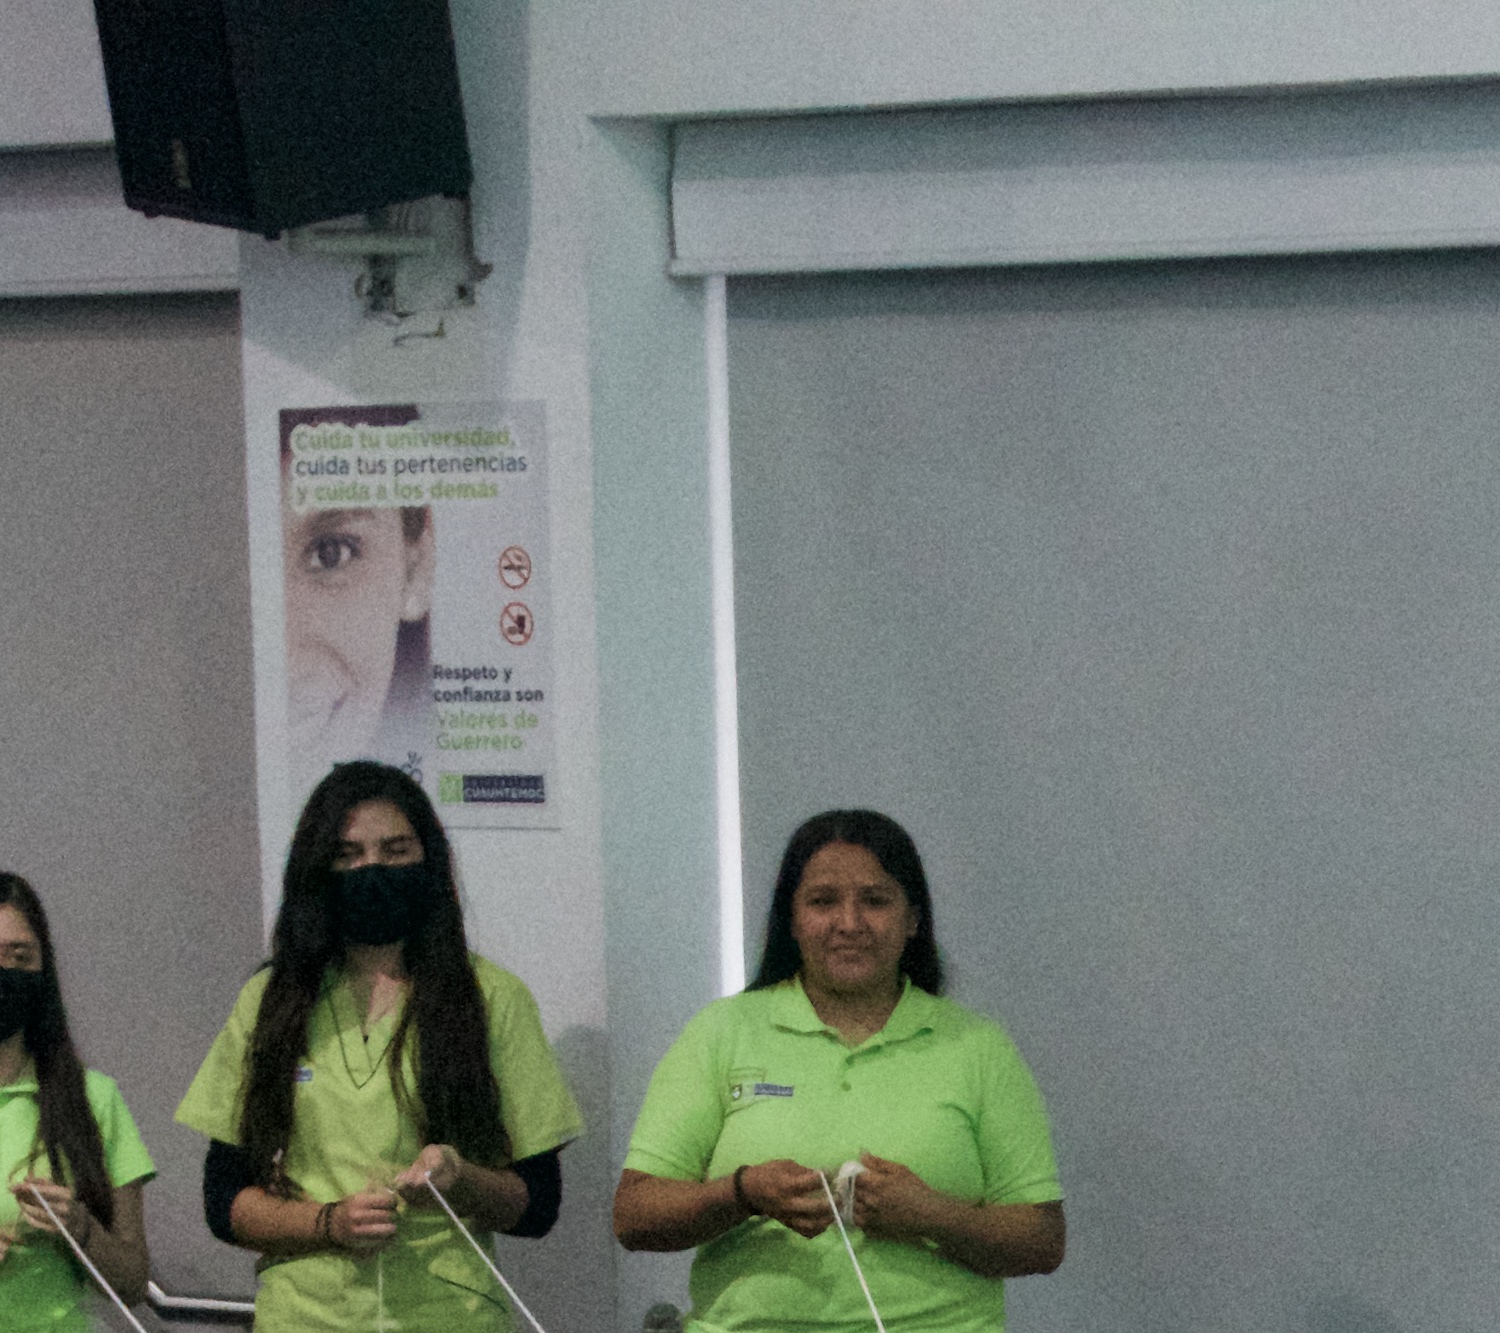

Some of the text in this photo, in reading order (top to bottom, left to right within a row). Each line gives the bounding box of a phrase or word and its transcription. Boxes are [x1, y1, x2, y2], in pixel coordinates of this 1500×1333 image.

[295, 431, 352, 448] Cuida
[359, 430, 381, 448] tu
[295, 454, 528, 476] cuida tus pertenencias
[296, 485, 307, 504] y
[315, 481, 370, 500] cuida
[394, 481, 423, 499] los
[432, 664, 513, 683] Respeto y
[433, 686, 544, 702] confianza son
[435, 709, 538, 728] Valores de
[436, 732, 522, 750] Guerrero
